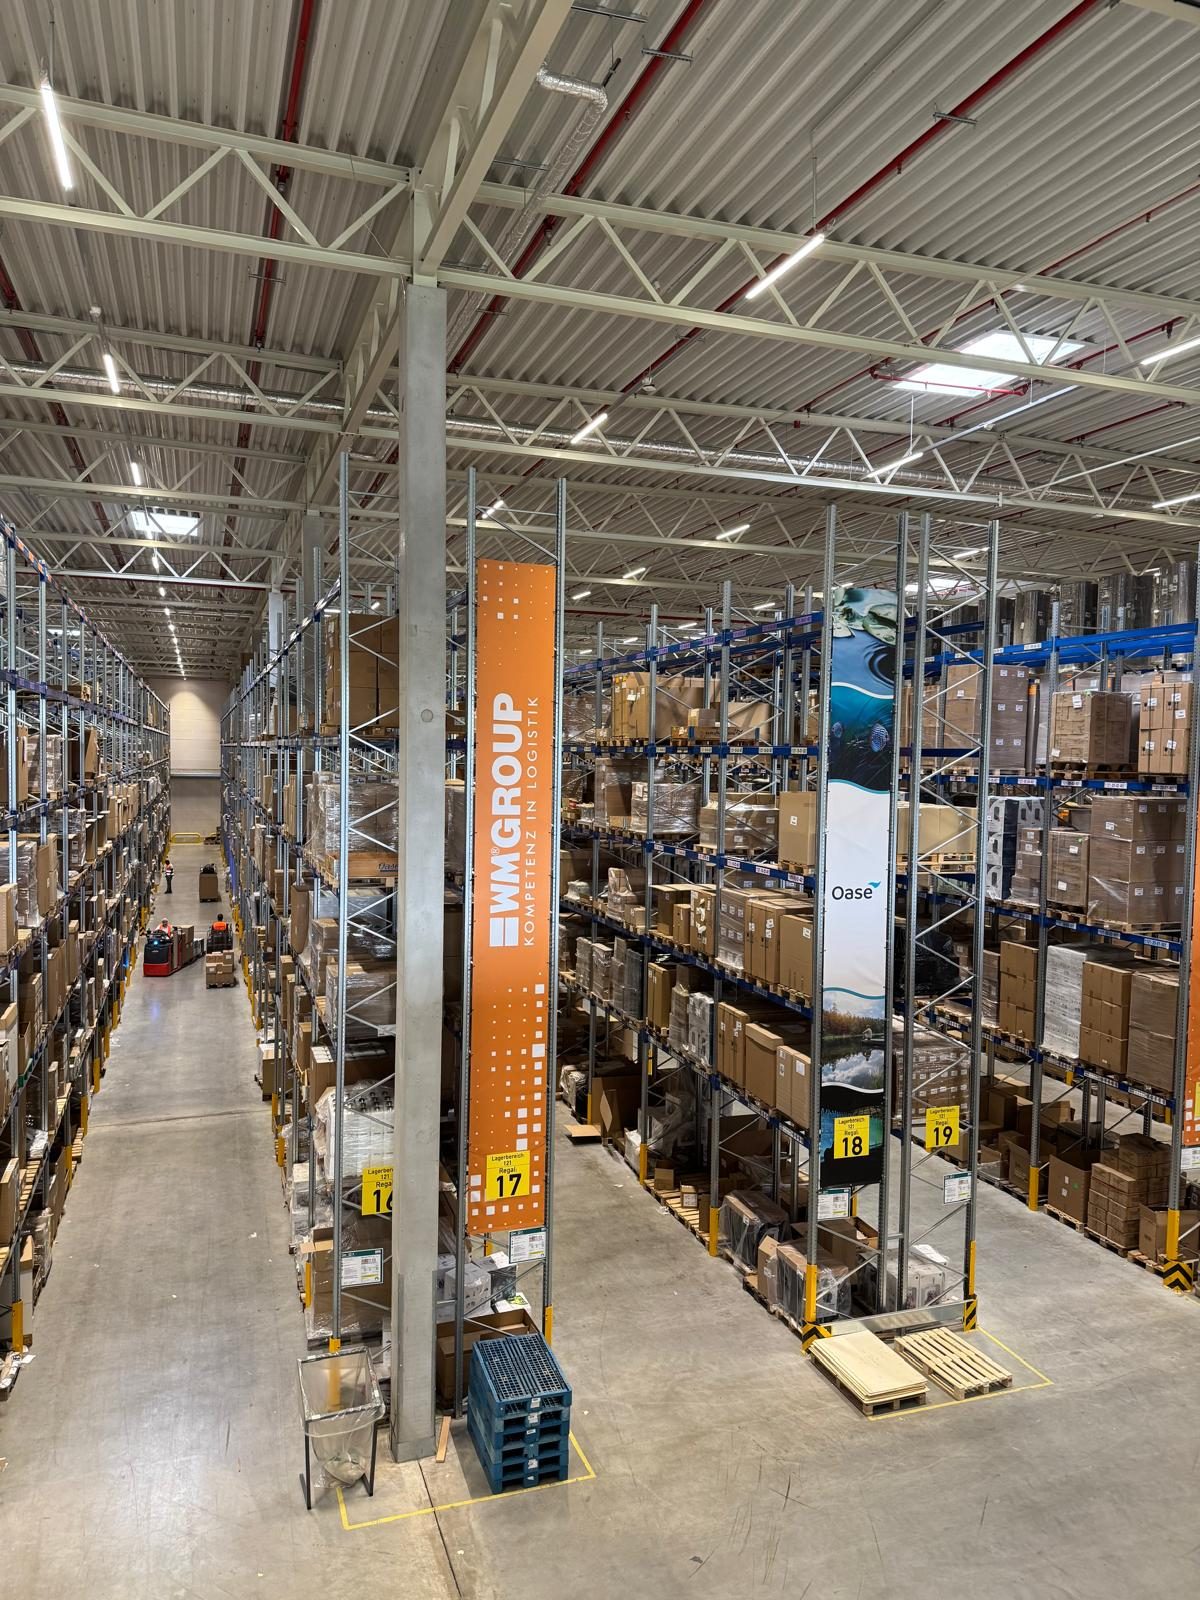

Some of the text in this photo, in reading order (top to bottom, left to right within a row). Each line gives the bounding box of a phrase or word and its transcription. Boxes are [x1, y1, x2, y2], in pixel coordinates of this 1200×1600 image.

[524, 696, 539, 946] KOMPETENZ IN LOGISTIK
[831, 886, 873, 900] Oase
[838, 1117, 865, 1125] Lagerbereich
[933, 1125, 953, 1146] 19
[842, 1136, 863, 1157] 18
[491, 1152, 525, 1162] Lagerbereich
[375, 1181, 393, 1189] Rega
[496, 1173, 522, 1198] 17
